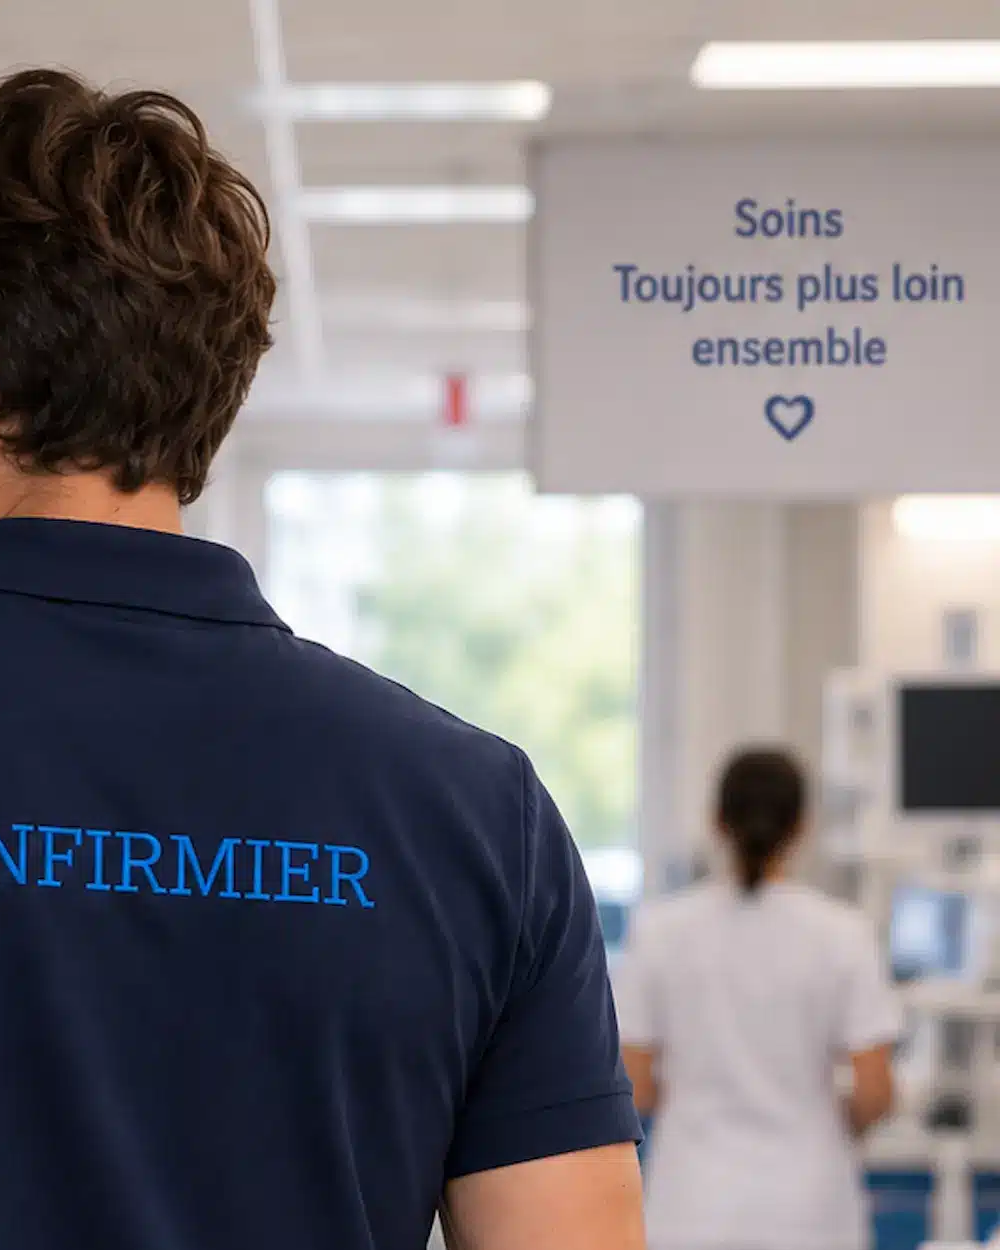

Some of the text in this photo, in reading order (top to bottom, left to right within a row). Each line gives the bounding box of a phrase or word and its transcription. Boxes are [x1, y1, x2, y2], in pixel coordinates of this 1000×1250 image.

[733, 197, 844, 240] Soins
[612, 262, 965, 313] Toujours plus loin
[690, 326, 888, 367] ensemble
